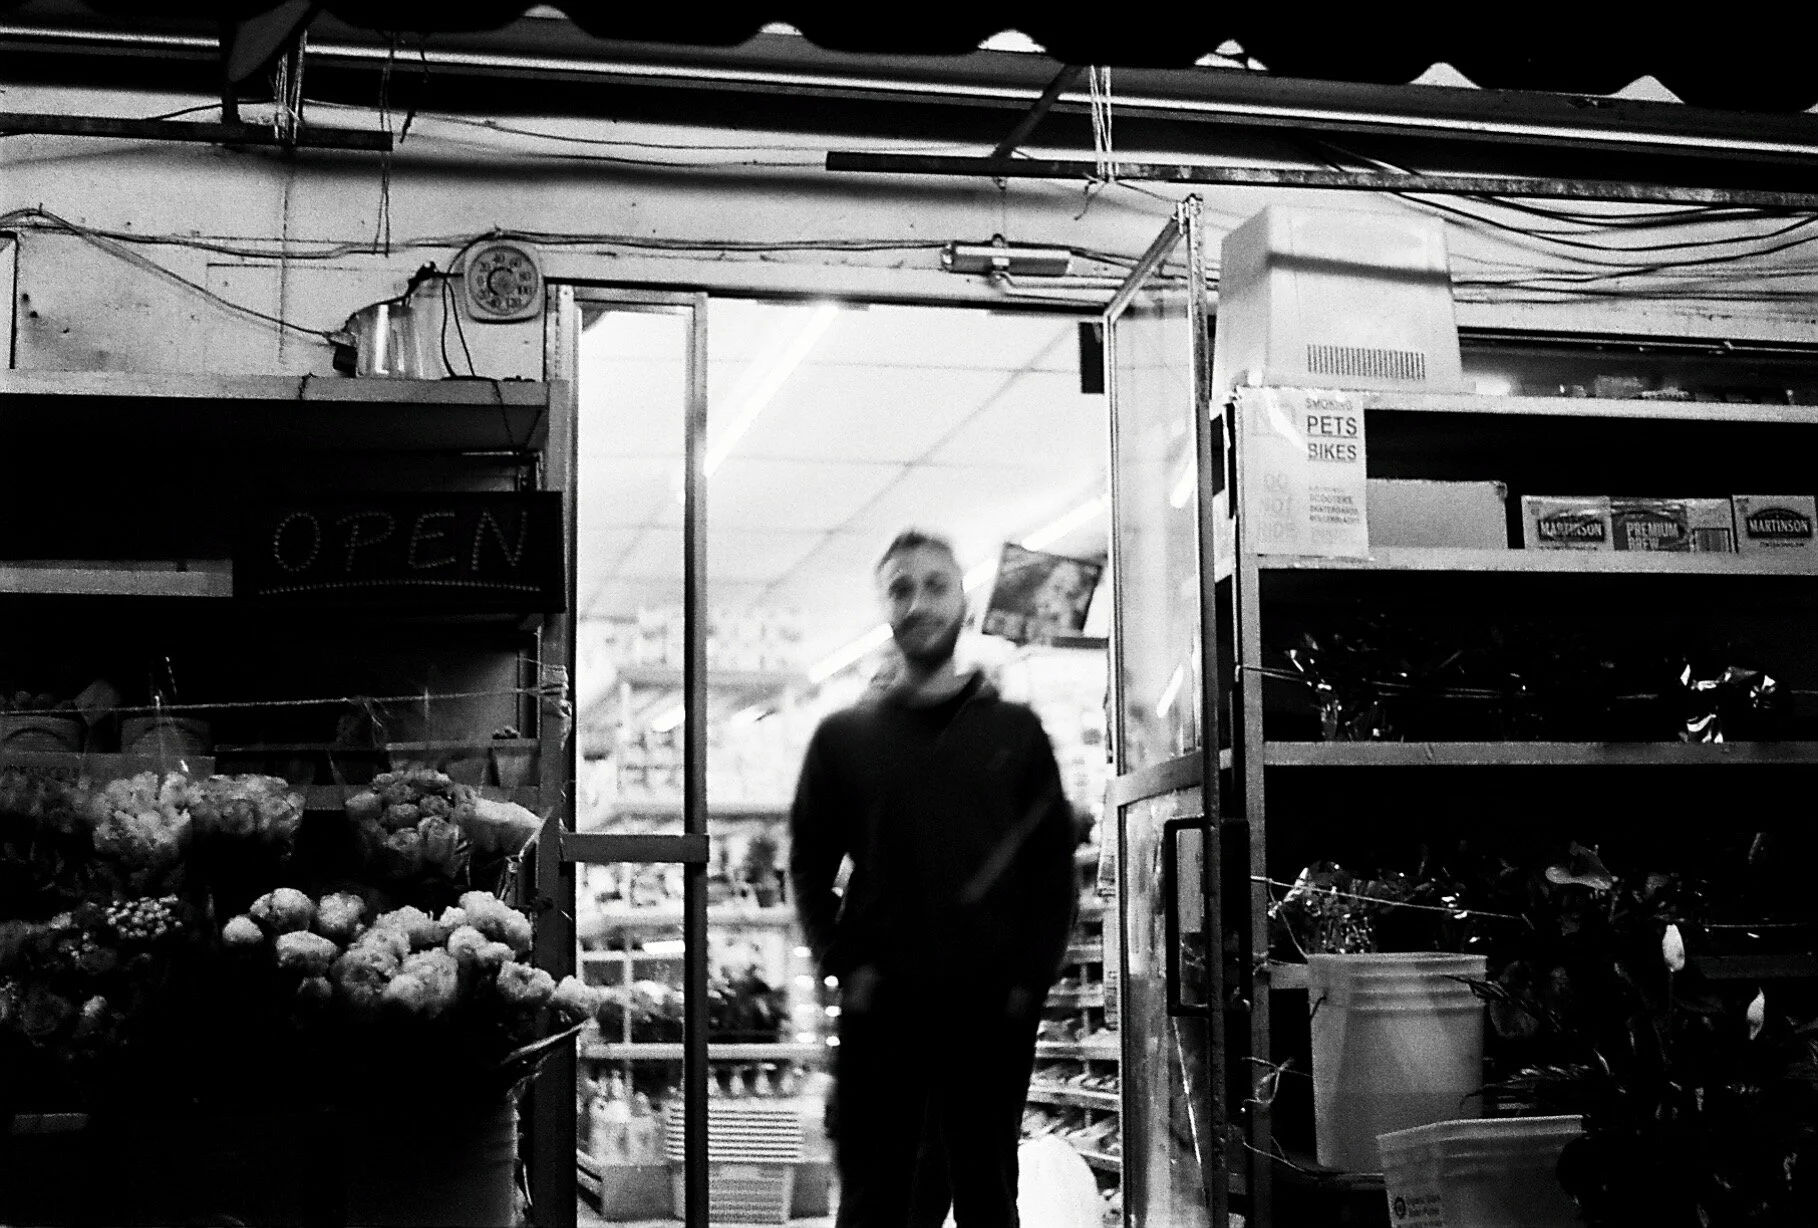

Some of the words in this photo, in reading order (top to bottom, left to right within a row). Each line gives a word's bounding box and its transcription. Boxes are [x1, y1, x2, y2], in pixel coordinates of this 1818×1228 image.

[1306, 415, 1358, 436] PETS
[1307, 442, 1358, 461] BIKES
[1626, 521, 1679, 538] PREMIUM
[1748, 519, 1809, 533] MARTINSON
[273, 510, 528, 572] OPEN
[1628, 537, 1660, 550] BREW
